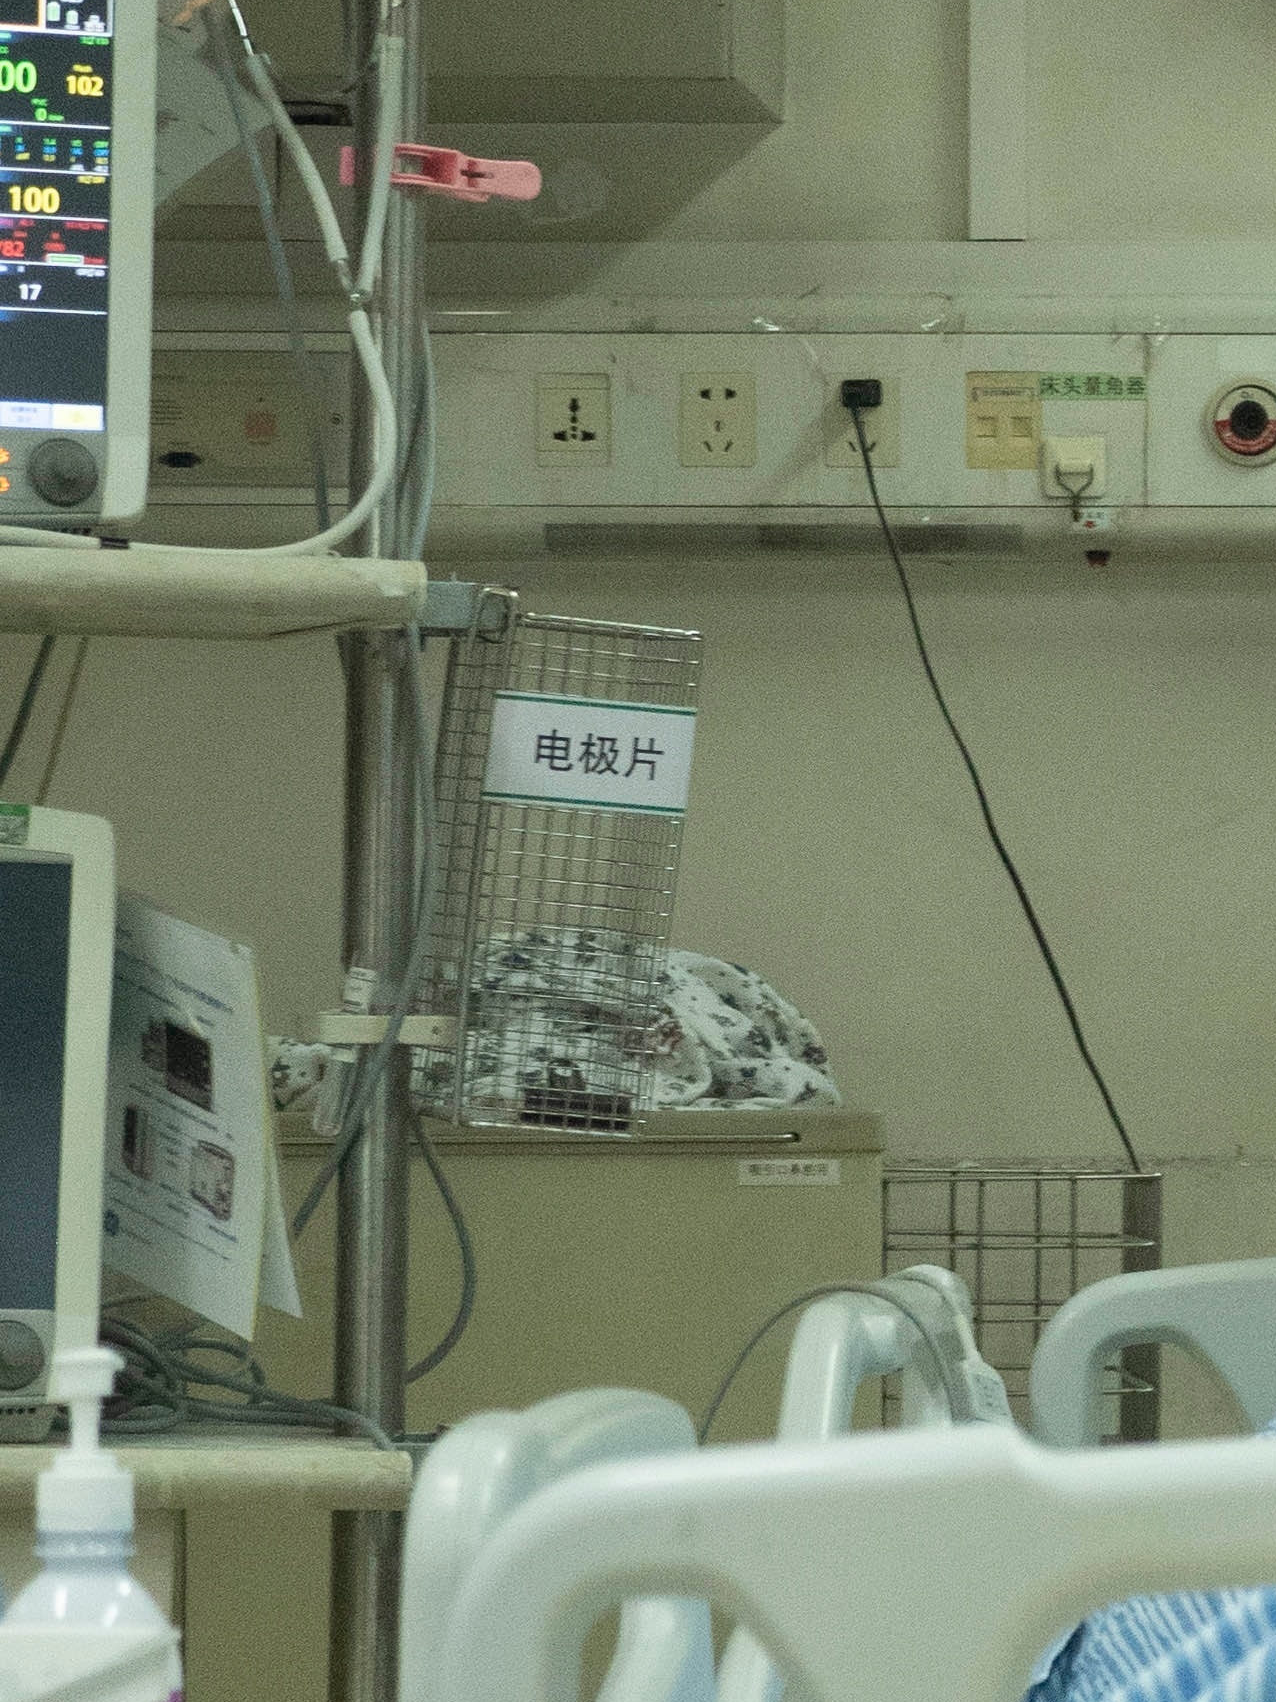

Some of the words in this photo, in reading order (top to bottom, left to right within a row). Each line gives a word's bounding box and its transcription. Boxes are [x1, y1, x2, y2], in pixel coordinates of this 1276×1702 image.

[66, 75, 104, 97] 102
[8, 185, 61, 214] 100
[18, 283, 43, 300] 17
[533, 728, 667, 782] 电极片
